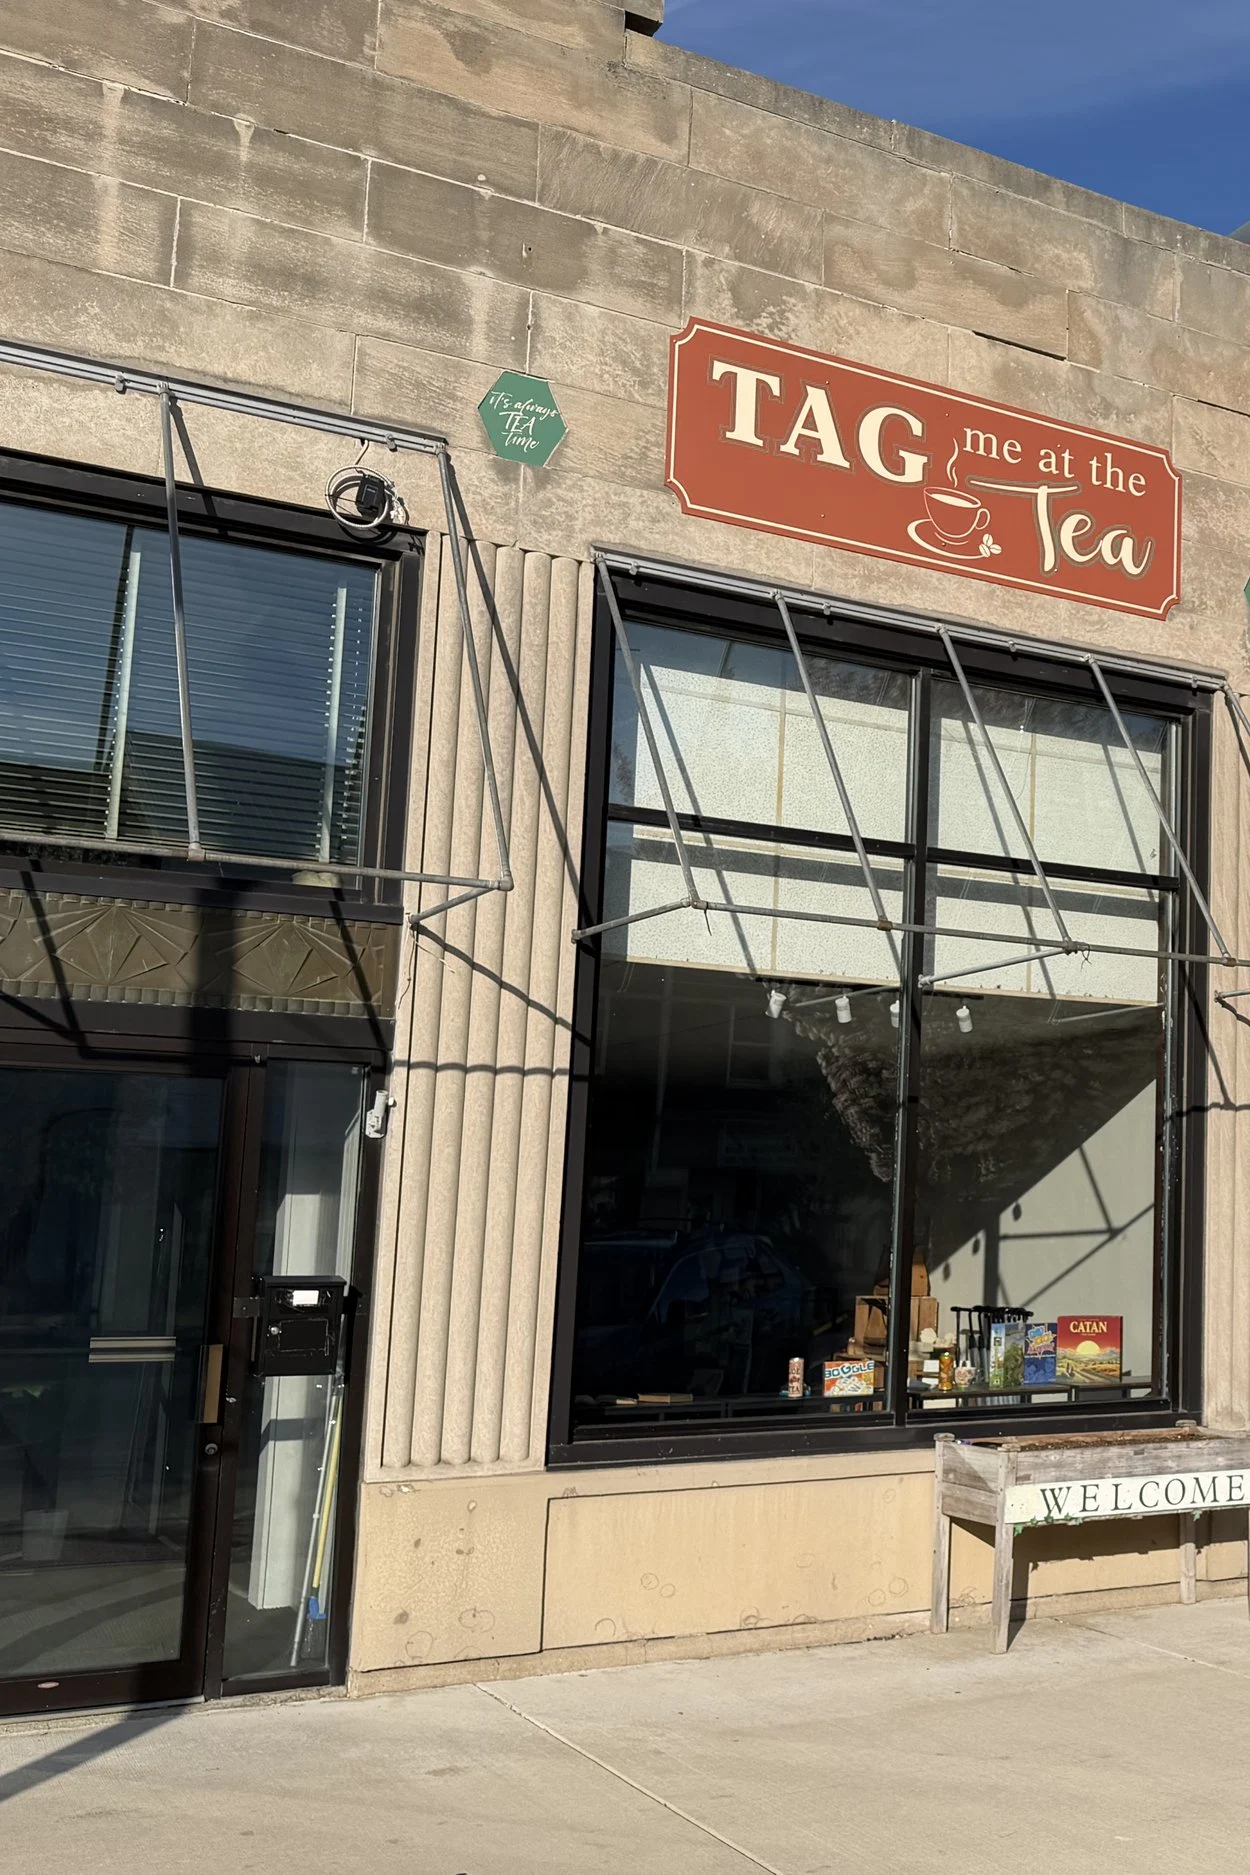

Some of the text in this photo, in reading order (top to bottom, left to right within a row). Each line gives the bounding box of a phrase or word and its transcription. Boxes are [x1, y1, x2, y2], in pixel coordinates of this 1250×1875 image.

[490, 391, 558, 420] it's always
[499, 412, 536, 435] TEA
[710, 358, 1147, 497] TAG me at the
[969, 479, 1152, 576] Tea
[1069, 1320, 1108, 1333] CATAN
[825, 1362, 874, 1378] BOGGLE
[1040, 1474, 1245, 1515] WELCOME
